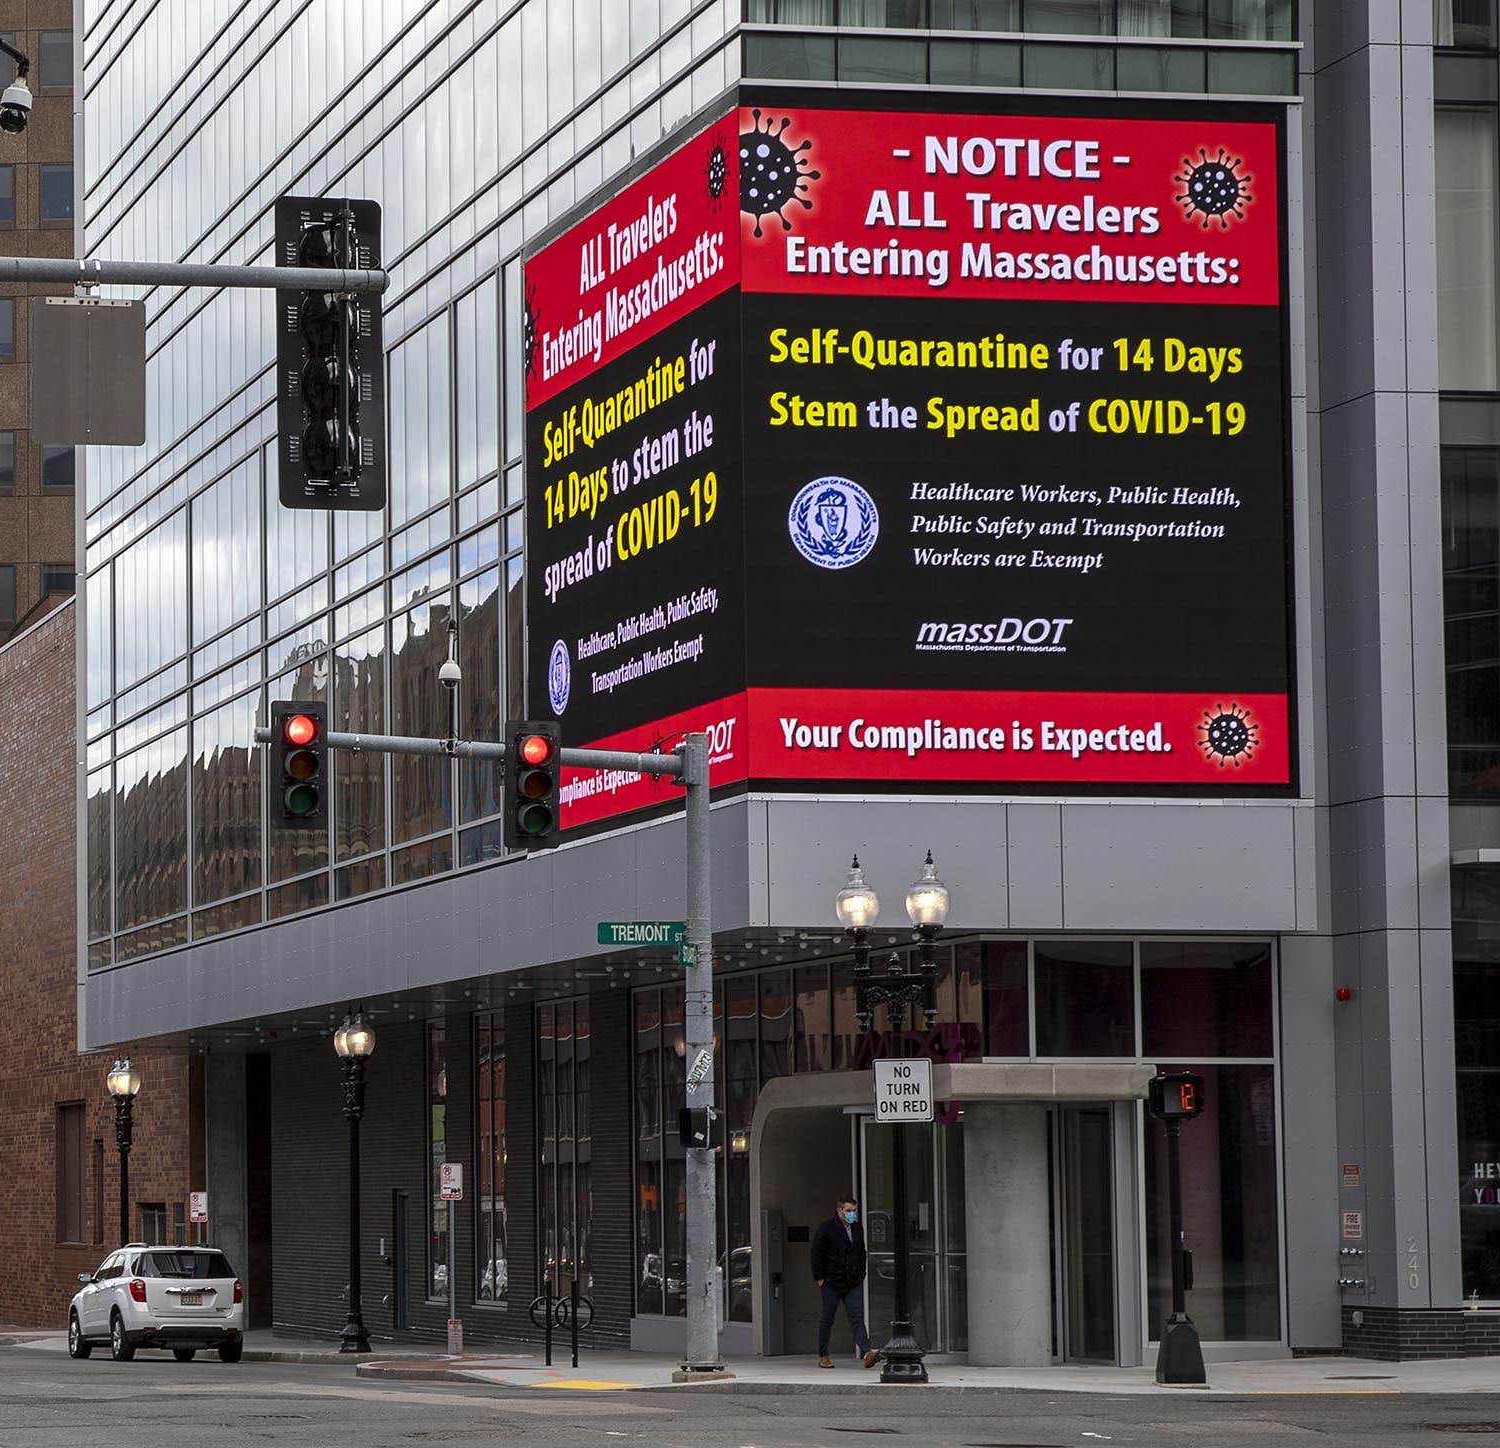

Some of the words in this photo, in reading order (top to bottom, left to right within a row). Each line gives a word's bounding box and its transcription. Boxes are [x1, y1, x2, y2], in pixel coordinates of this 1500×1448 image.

[925, 136, 1100, 178] NOTICE
[865, 190, 946, 227] ALL
[967, 193, 1160, 234] Travelers
[579, 233, 605, 295] ALL
[607, 193, 677, 276] Travelers
[786, 237, 948, 286] Entering
[960, 243, 1239, 284] Massachusetts:
[542, 309, 602, 381] Entering
[605, 231, 723, 342] Massachusetts:
[769, 328, 1048, 370] Self-Quarantine
[1059, 339, 1103, 371] for
[1113, 338, 1154, 372] 14
[1165, 339, 1243, 382] Days
[543, 355, 685, 468] Self-Quarantine
[689, 338, 716, 386] for
[770, 392, 856, 427] Stem
[867, 399, 917, 430] the
[927, 397, 1040, 438] Spread
[1048, 402, 1080, 432] of
[1088, 400, 1246, 436] COVID-19
[544, 480, 564, 529] 14
[568, 465, 608, 521] Days
[611, 457, 629, 495] to
[632, 427, 679, 486] stem
[684, 410, 713, 459] the
[910, 482, 1014, 502] Healthcare
[1020, 484, 1102, 506] Workers,
[1107, 486, 1167, 506] Public
[1172, 487, 1241, 508] Health,
[544, 535, 593, 604] spread
[596, 524, 614, 572] of
[616, 471, 718, 561] COVID-19
[910, 515, 971, 535] Public
[975, 516, 1034, 539] Safety
[1039, 518, 1076, 536] and
[1081, 518, 1225, 541] Transportation
[913, 548, 990, 568] Workers
[995, 553, 1026, 568] are
[1030, 550, 1104, 572] Exempt
[577, 631, 617, 660] Healthcare,
[617, 616, 639, 645] Public
[639, 605, 667, 636] Health,
[667, 595, 691, 625] Public
[691, 587, 719, 615] Safety,
[916, 618, 1073, 644] massDOT
[591, 657, 643, 694] Transportation
[643, 646, 674, 675] Workers
[674, 633, 703, 663] Exempt
[965, 644, 1006, 652] Department
[1006, 644, 1015, 652] of
[1016, 645, 1066, 653] Transportation
[780, 717, 841, 749] Your
[848, 718, 1005, 755] Compliance
[1012, 720, 1033, 751] is
[1041, 721, 1172, 757] Expected.
[595, 769, 603, 793] is
[610, 925, 670, 942] TREMONT
[674, 932, 683, 942] ST
[886, 1083, 920, 1096] TURN
[893, 1066, 911, 1078] NO
[880, 1101, 898, 1113] ON
[903, 1100, 928, 1113] RED
[1406, 1236, 1420, 1289] 240
